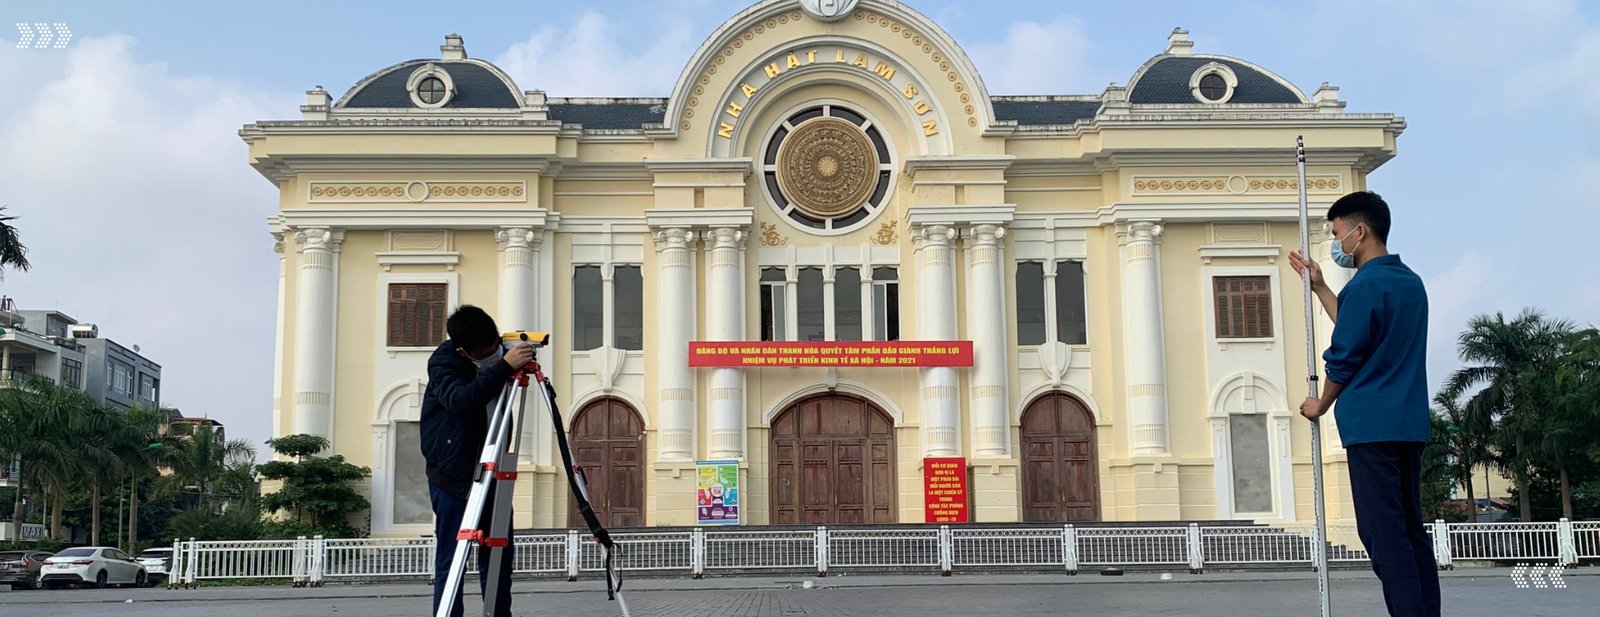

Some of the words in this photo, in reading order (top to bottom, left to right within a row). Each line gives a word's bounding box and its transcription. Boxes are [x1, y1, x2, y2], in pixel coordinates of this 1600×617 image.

[718, 82, 759, 139] NHÀ
[763, 49, 818, 80] HÁT
[836, 48, 897, 81] LAM
[902, 83, 939, 138] SƠN
[779, 347, 802, 355] THANH
[821, 356, 838, 365] KINH
